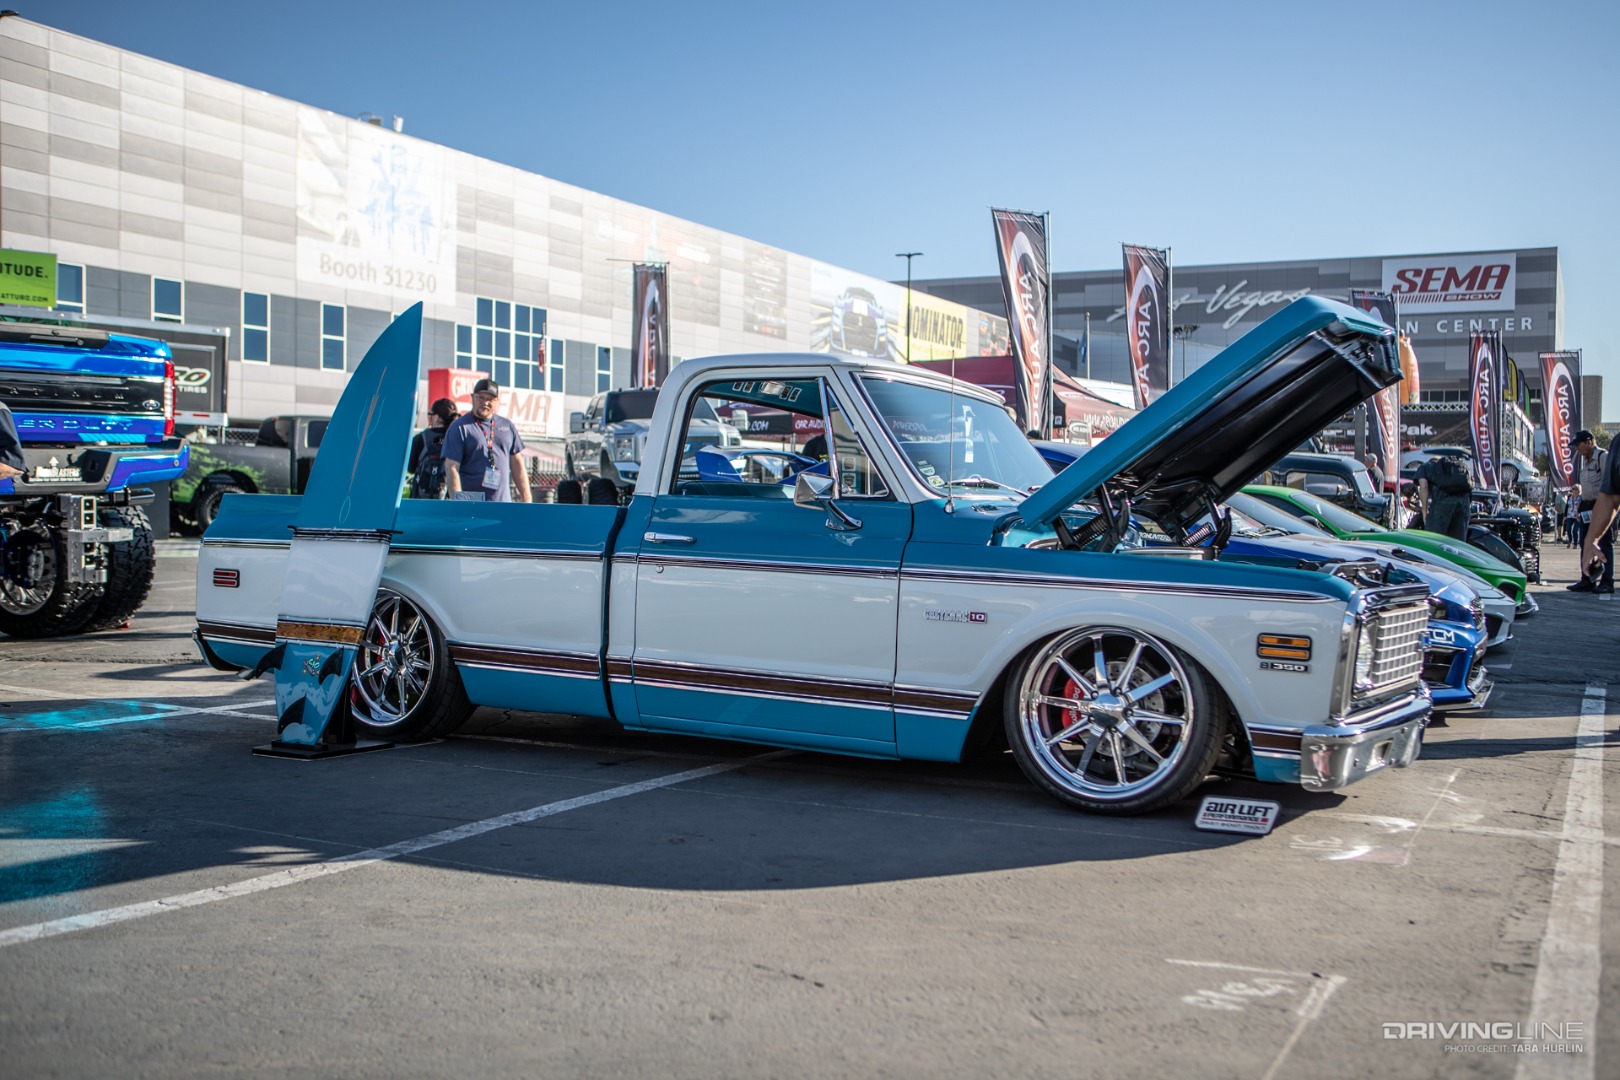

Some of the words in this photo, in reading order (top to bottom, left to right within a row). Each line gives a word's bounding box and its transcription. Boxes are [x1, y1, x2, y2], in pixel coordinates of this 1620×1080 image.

[320, 253, 377, 284] Booth
[383, 264, 437, 294] 31230
[1391, 263, 1511, 294] SEMA
[1445, 292, 1500, 301] SHOW
[1436, 316, 1533, 333] CENTER
[177, 385, 208, 394] TIRES
[748, 420, 769, 431] .COM
[971, 613, 986, 622] 10
[1273, 662, 1306, 672] 350
[1238, 804, 1273, 817] LIFT
